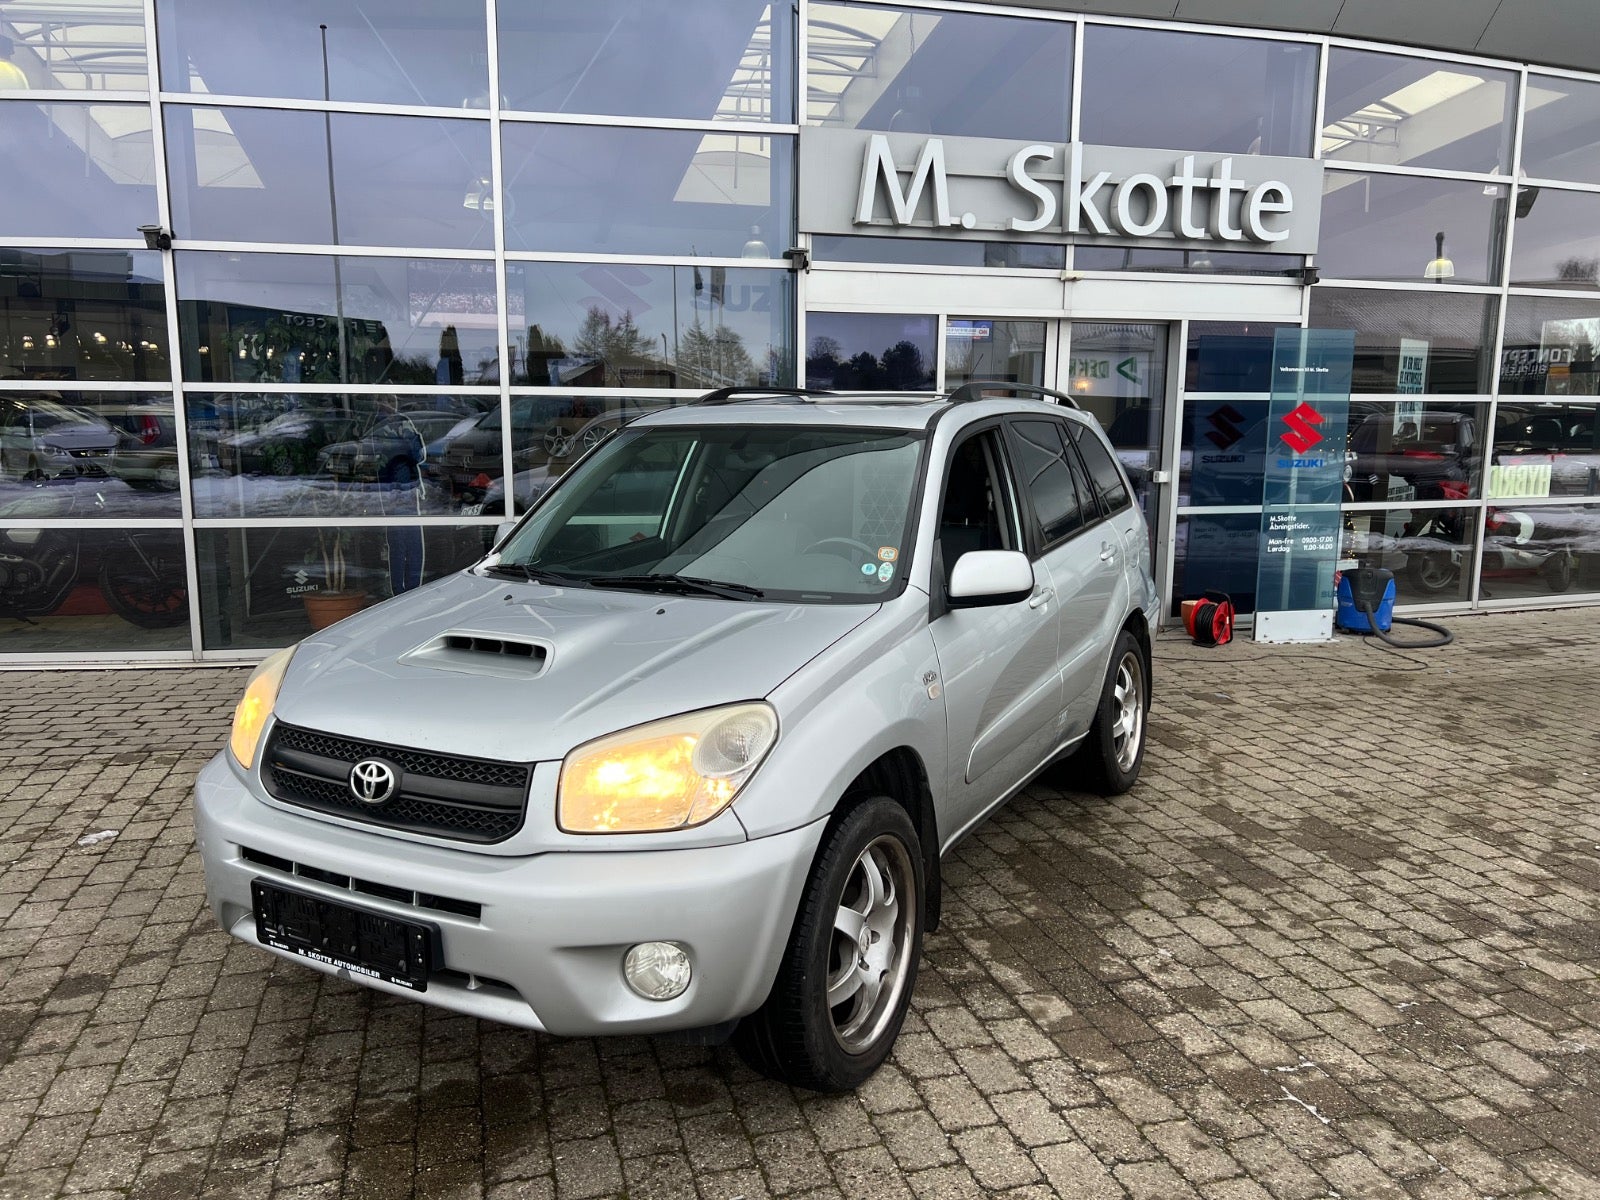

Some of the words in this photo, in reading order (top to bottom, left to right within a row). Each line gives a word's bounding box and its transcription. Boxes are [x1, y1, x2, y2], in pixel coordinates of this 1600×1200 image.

[855, 134, 976, 229] M.
[1006, 141, 1293, 243] Skotte
[1277, 459, 1323, 468] SUZUKI
[1269, 522, 1310, 531] Åbningstider.
[1267, 545, 1291, 553] Lørdag
[286, 585, 319, 594] SUZUKI
[307, 951, 332, 964] SKOTTE
[333, 959, 380, 978] AUTOMOBILER
